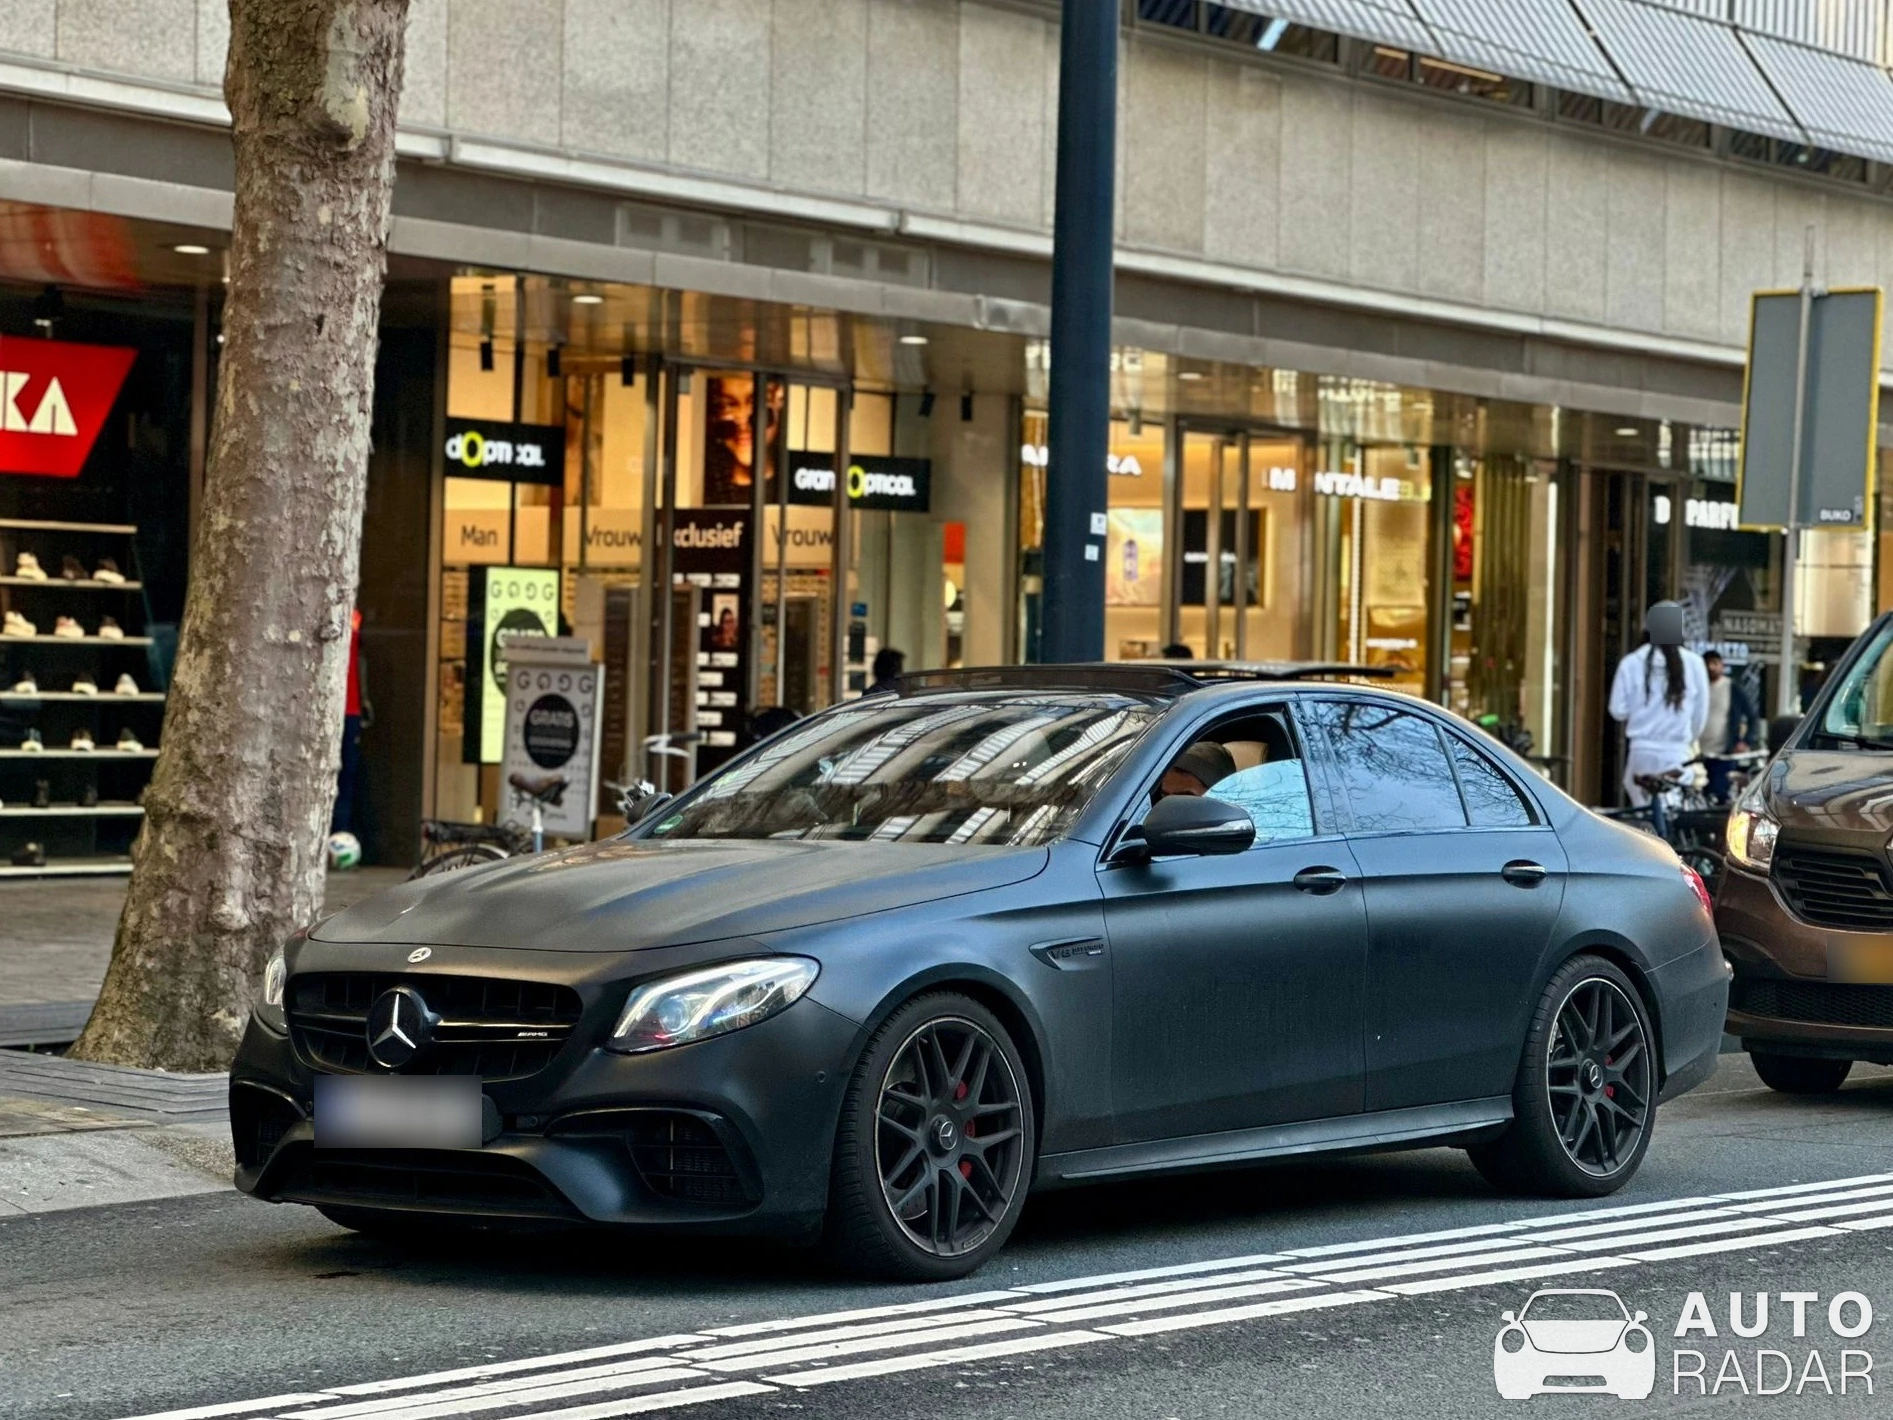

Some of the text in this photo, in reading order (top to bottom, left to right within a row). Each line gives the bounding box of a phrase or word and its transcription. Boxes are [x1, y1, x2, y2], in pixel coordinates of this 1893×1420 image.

[1269, 467, 1400, 501] MNTALE
[1819, 509, 1852, 522] BUKO
[460, 525, 498, 546] Man
